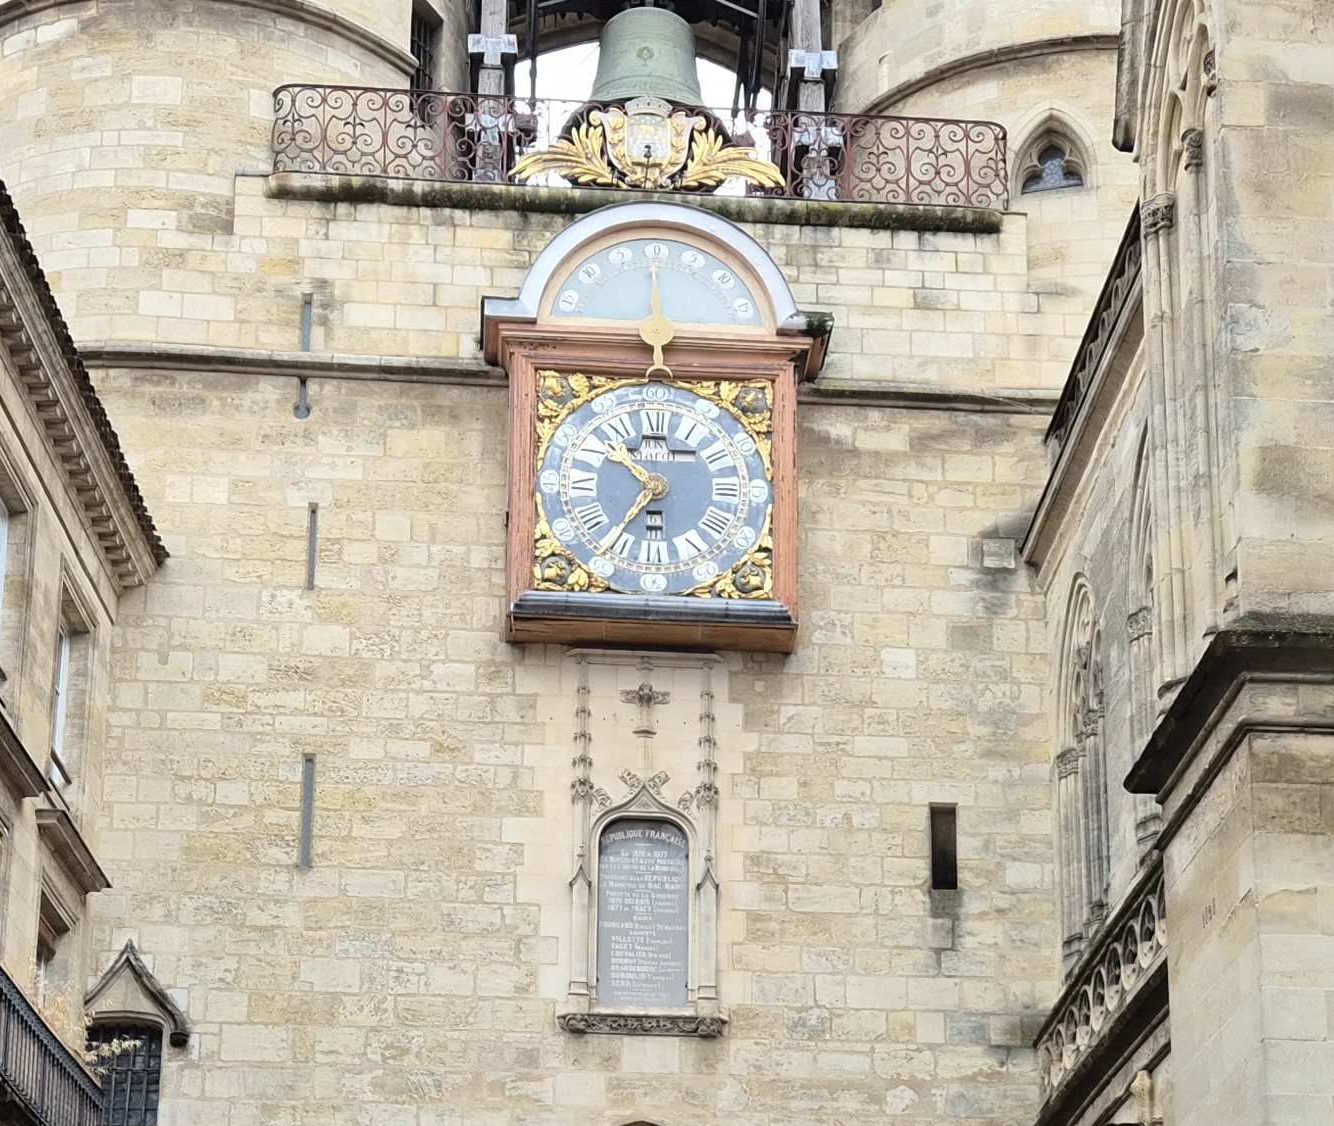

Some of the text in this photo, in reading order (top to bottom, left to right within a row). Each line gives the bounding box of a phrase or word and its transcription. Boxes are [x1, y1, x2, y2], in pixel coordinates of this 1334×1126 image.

[653, 244, 661, 256] 0
[583, 267, 596, 279] 10
[718, 273, 731, 285] 10
[646, 386, 666, 400] 60
[644, 410, 665, 433] XII
[556, 425, 576, 445] 50
[643, 440, 665, 450] JUIN
[736, 436, 754, 453] 10
[542, 472, 558, 492] 45
[554, 519, 573, 538] 40
[735, 528, 755, 548] 20
[642, 574, 664, 589] 30
